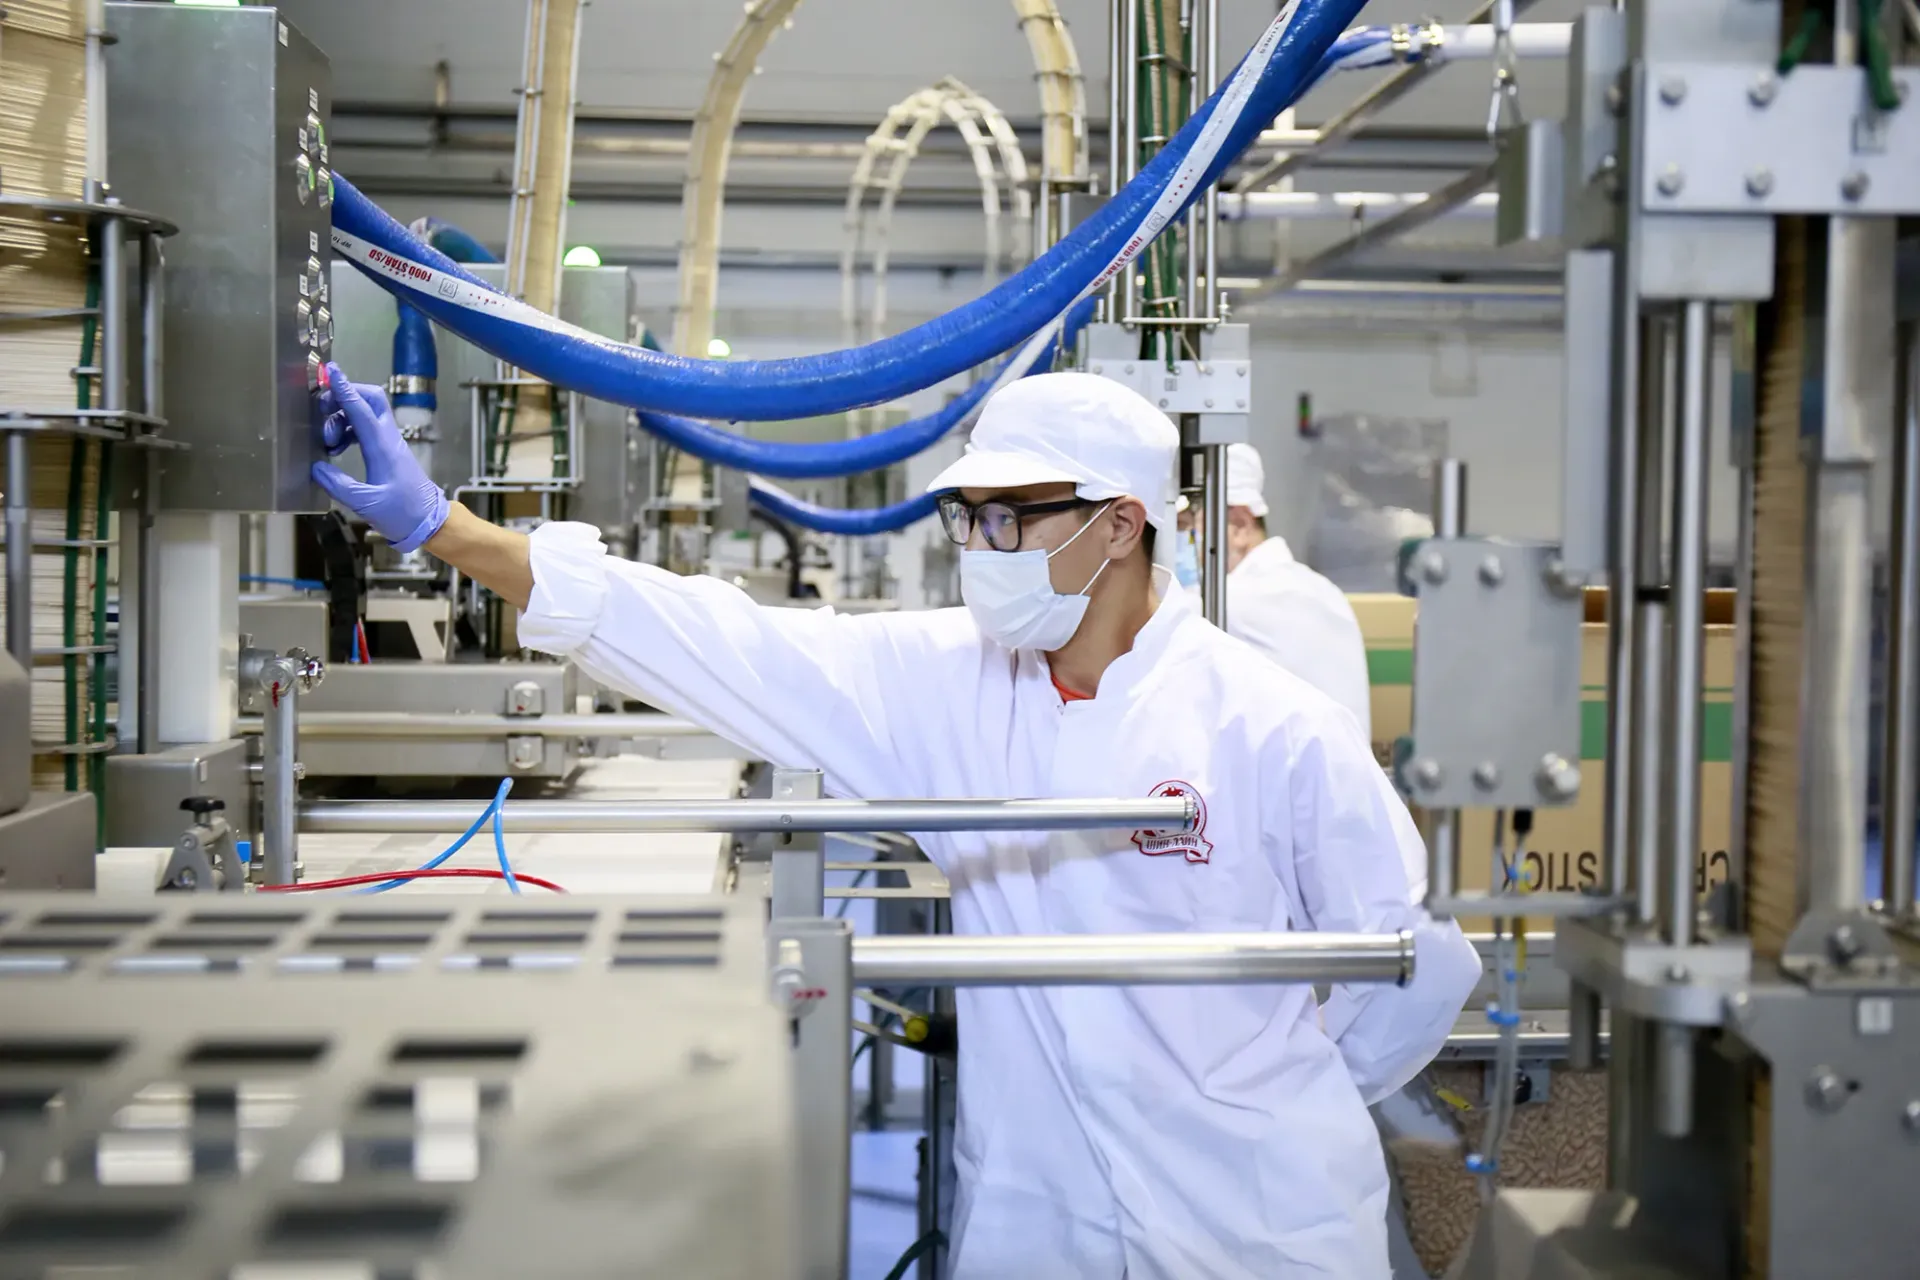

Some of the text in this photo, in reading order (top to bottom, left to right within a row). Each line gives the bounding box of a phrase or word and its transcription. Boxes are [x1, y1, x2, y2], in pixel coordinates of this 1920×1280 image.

[1123, 236, 1143, 256] FOOD
[368, 248, 408, 272] STAR/SD
[408, 265, 432, 282] FOOD
[1502, 851, 1598, 893] STICK
